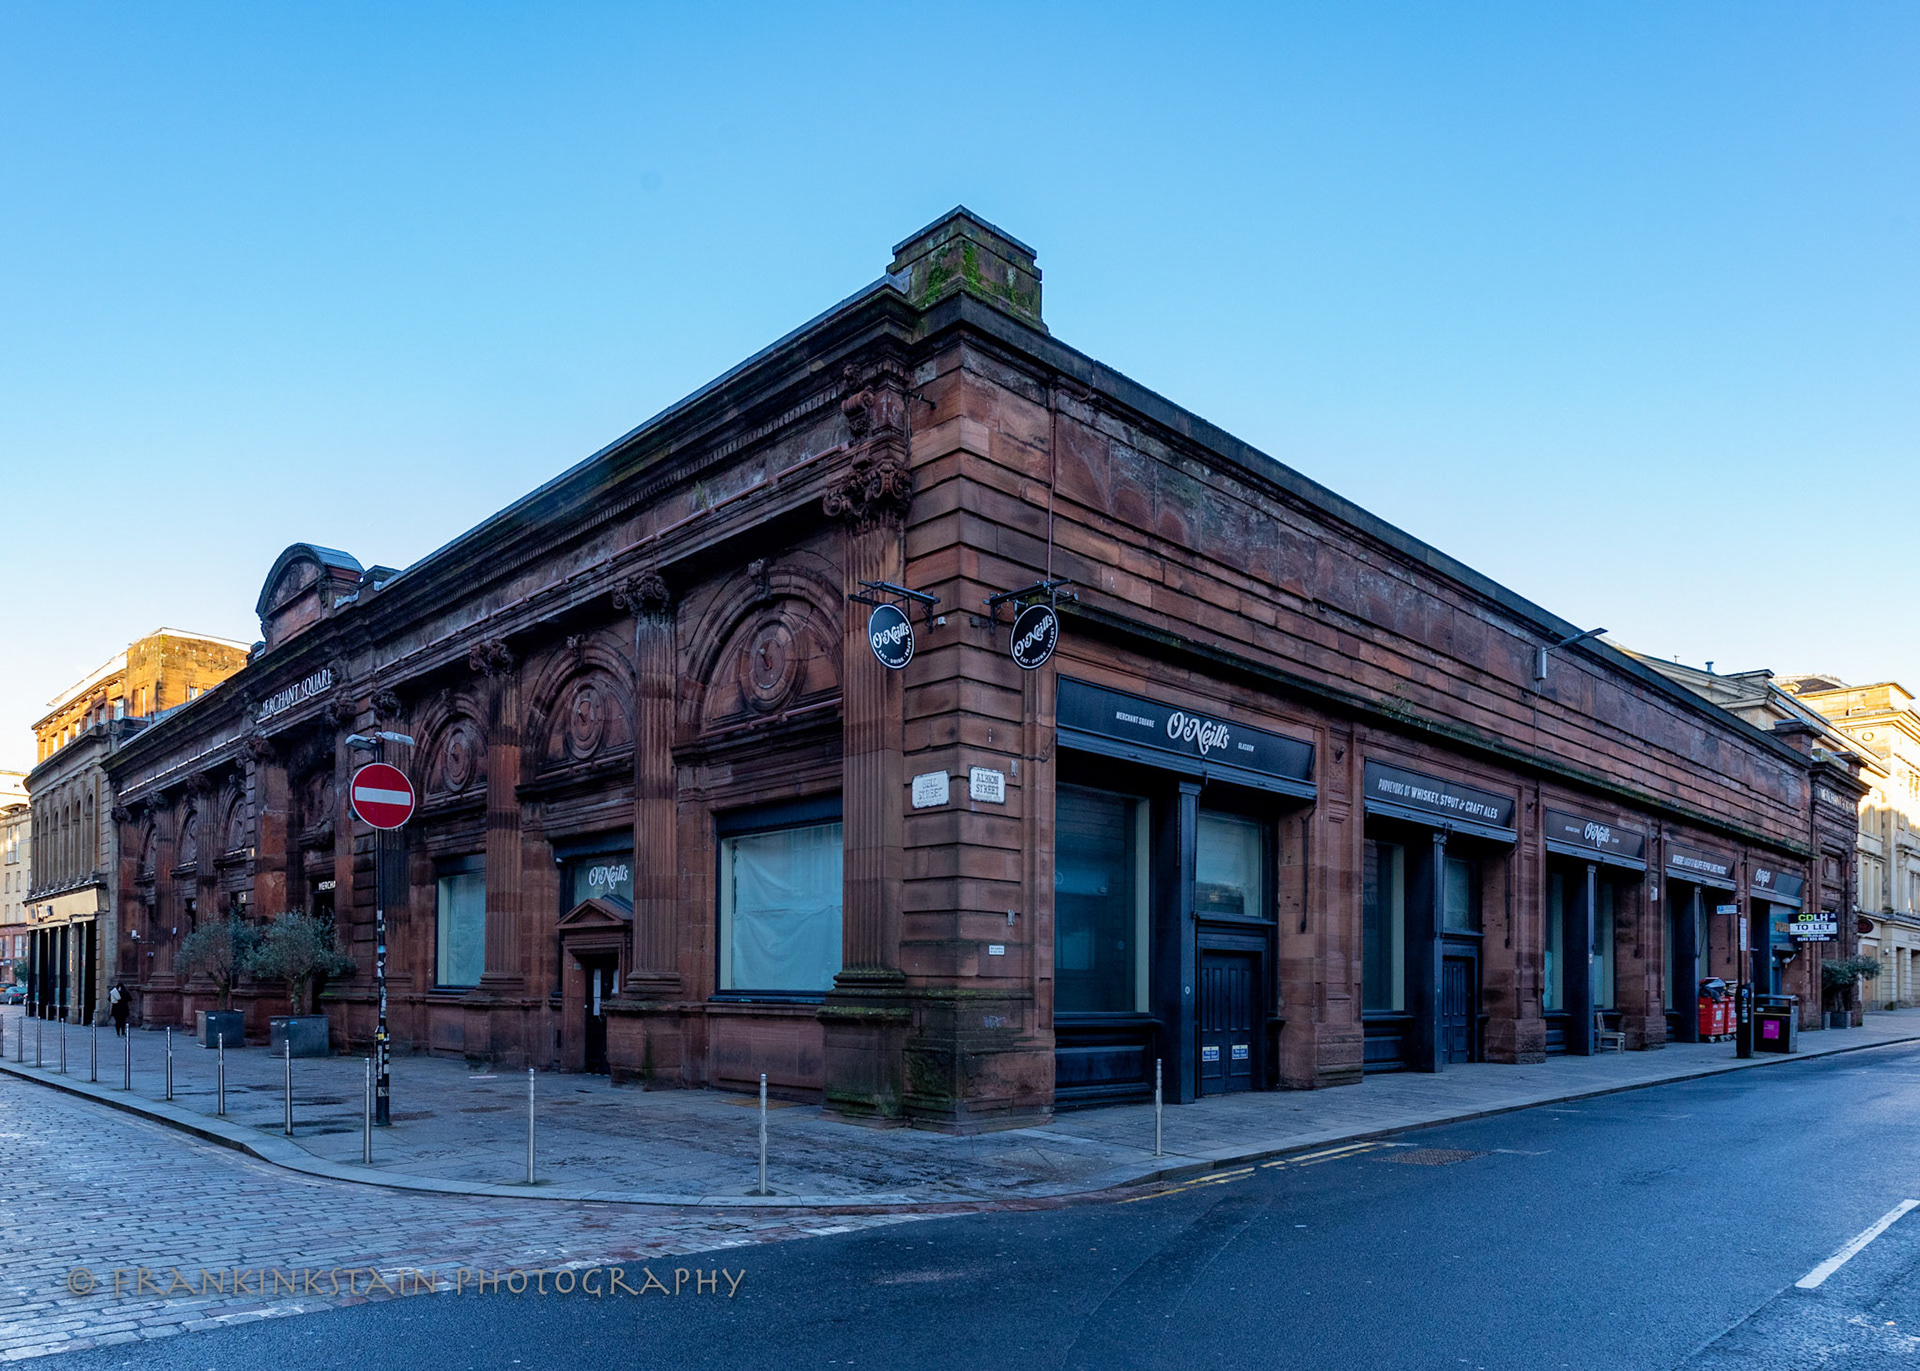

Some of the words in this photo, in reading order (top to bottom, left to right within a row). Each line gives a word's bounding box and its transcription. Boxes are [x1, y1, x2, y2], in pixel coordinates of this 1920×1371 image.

[873, 622, 910, 649] O'Neill's
[1014, 615, 1053, 657] O'Neill's
[260, 683, 300, 718] MERCHANT
[301, 669, 332, 697] SQUARE
[1115, 711, 1138, 724] MERCHANT
[1138, 717, 1155, 728] SQUARE
[1166, 711, 1230, 755] O'Neill's
[975, 784, 999, 795] STREET
[976, 773, 999, 785] ALBION
[918, 788, 943, 800] STREET
[1377, 779, 1404, 796] PURVEYORS
[1404, 786, 1411, 796] OF
[1411, 786, 1439, 806] WHISKEY,
[1440, 794, 1460, 809] STOUT
[1459, 800, 1466, 810] &
[1465, 801, 1484, 816] CRAFT
[1483, 805, 1498, 819] ALES
[1584, 822, 1610, 847] O'Neill's
[589, 864, 629, 890] O'Neill's
[1797, 913, 1828, 922] CDLH
